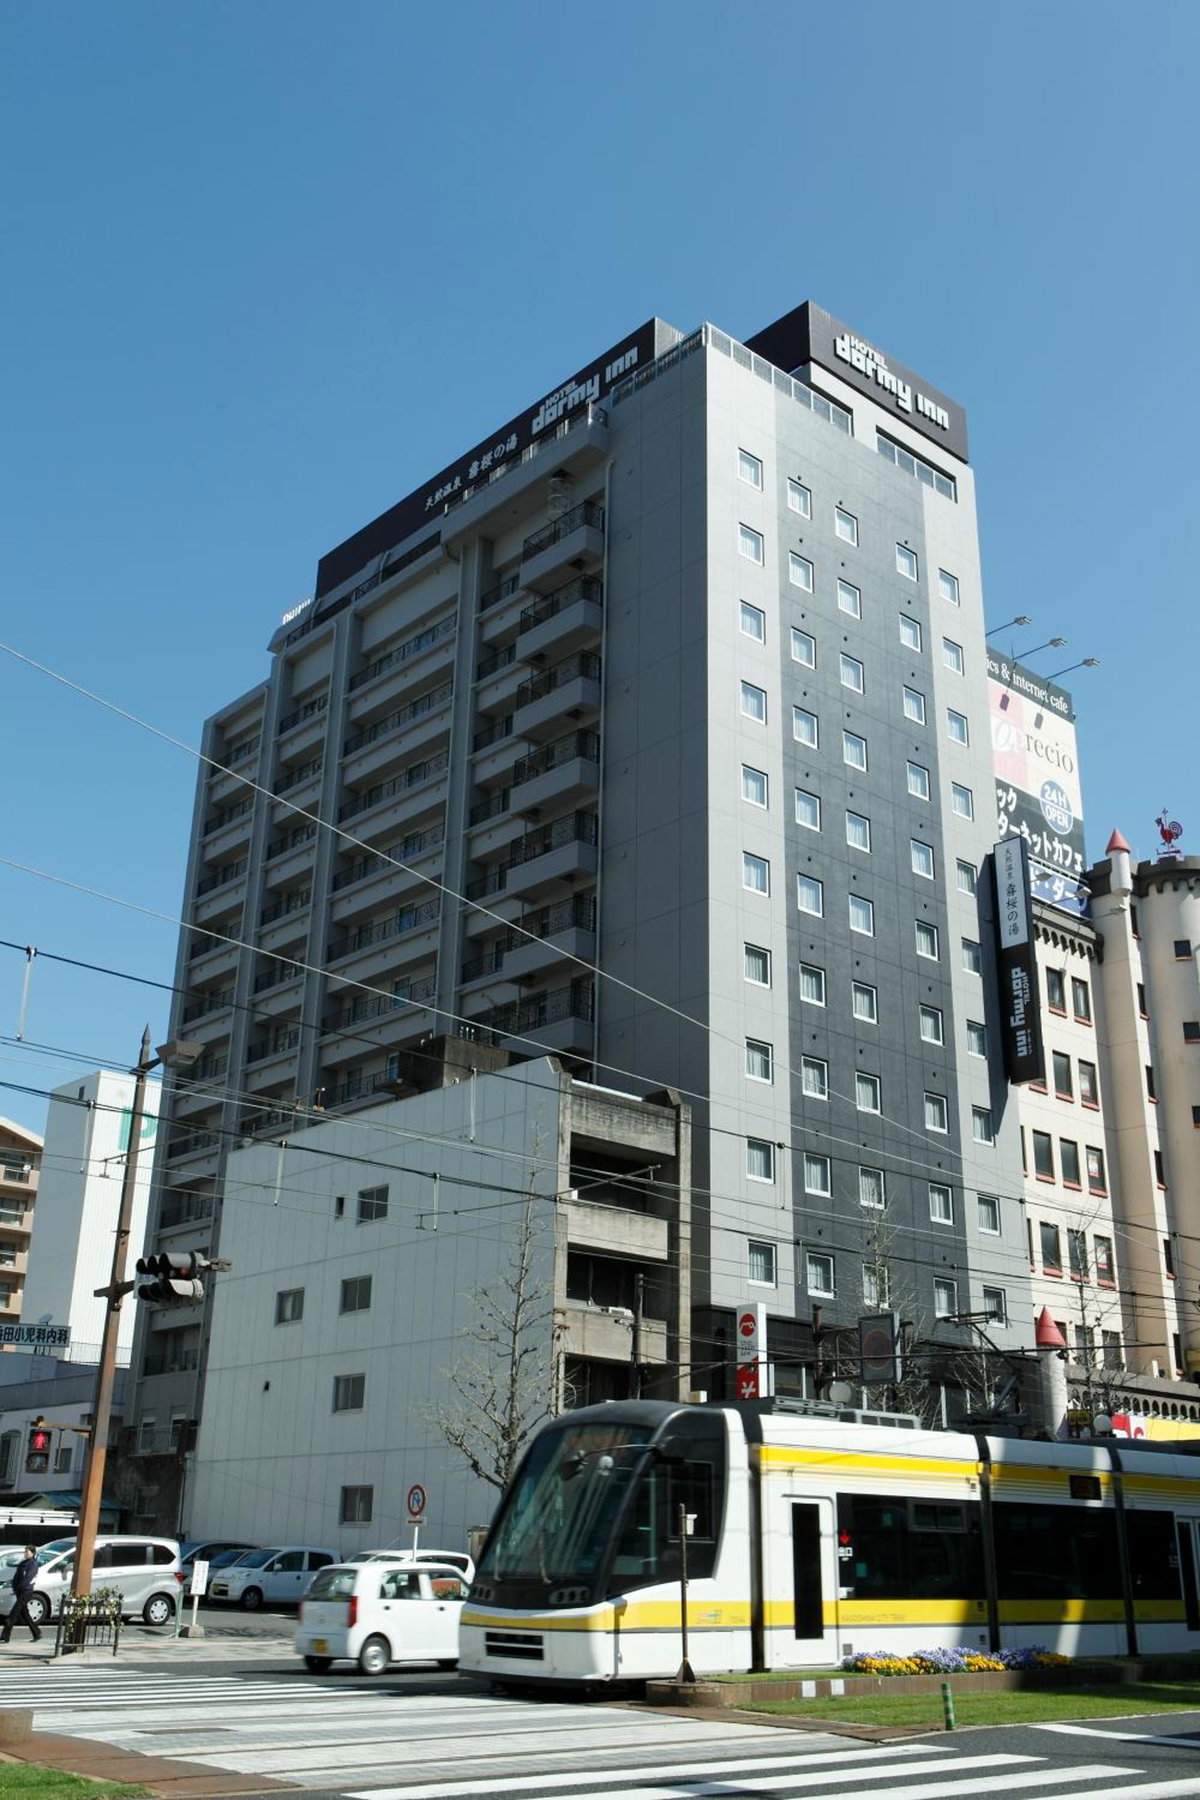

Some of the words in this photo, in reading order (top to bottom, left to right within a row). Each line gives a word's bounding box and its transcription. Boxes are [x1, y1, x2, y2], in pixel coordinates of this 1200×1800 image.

[850, 335, 888, 369] HOTEL
[531, 374, 600, 435] dormy
[605, 346, 638, 383] inn
[545, 380, 578, 408] HOTEL
[836, 333, 913, 414] dormy
[917, 392, 950, 430] inn
[1001, 663, 1011, 681] &
[1012, 669, 1049, 703] internet
[1049, 695, 1069, 713] cafe
[1045, 805, 1069, 828] OPEN
[1010, 966, 1027, 1028] dormy
[1022, 976, 1031, 1006] HOTEL
[1016, 1030, 1028, 1057] inn
